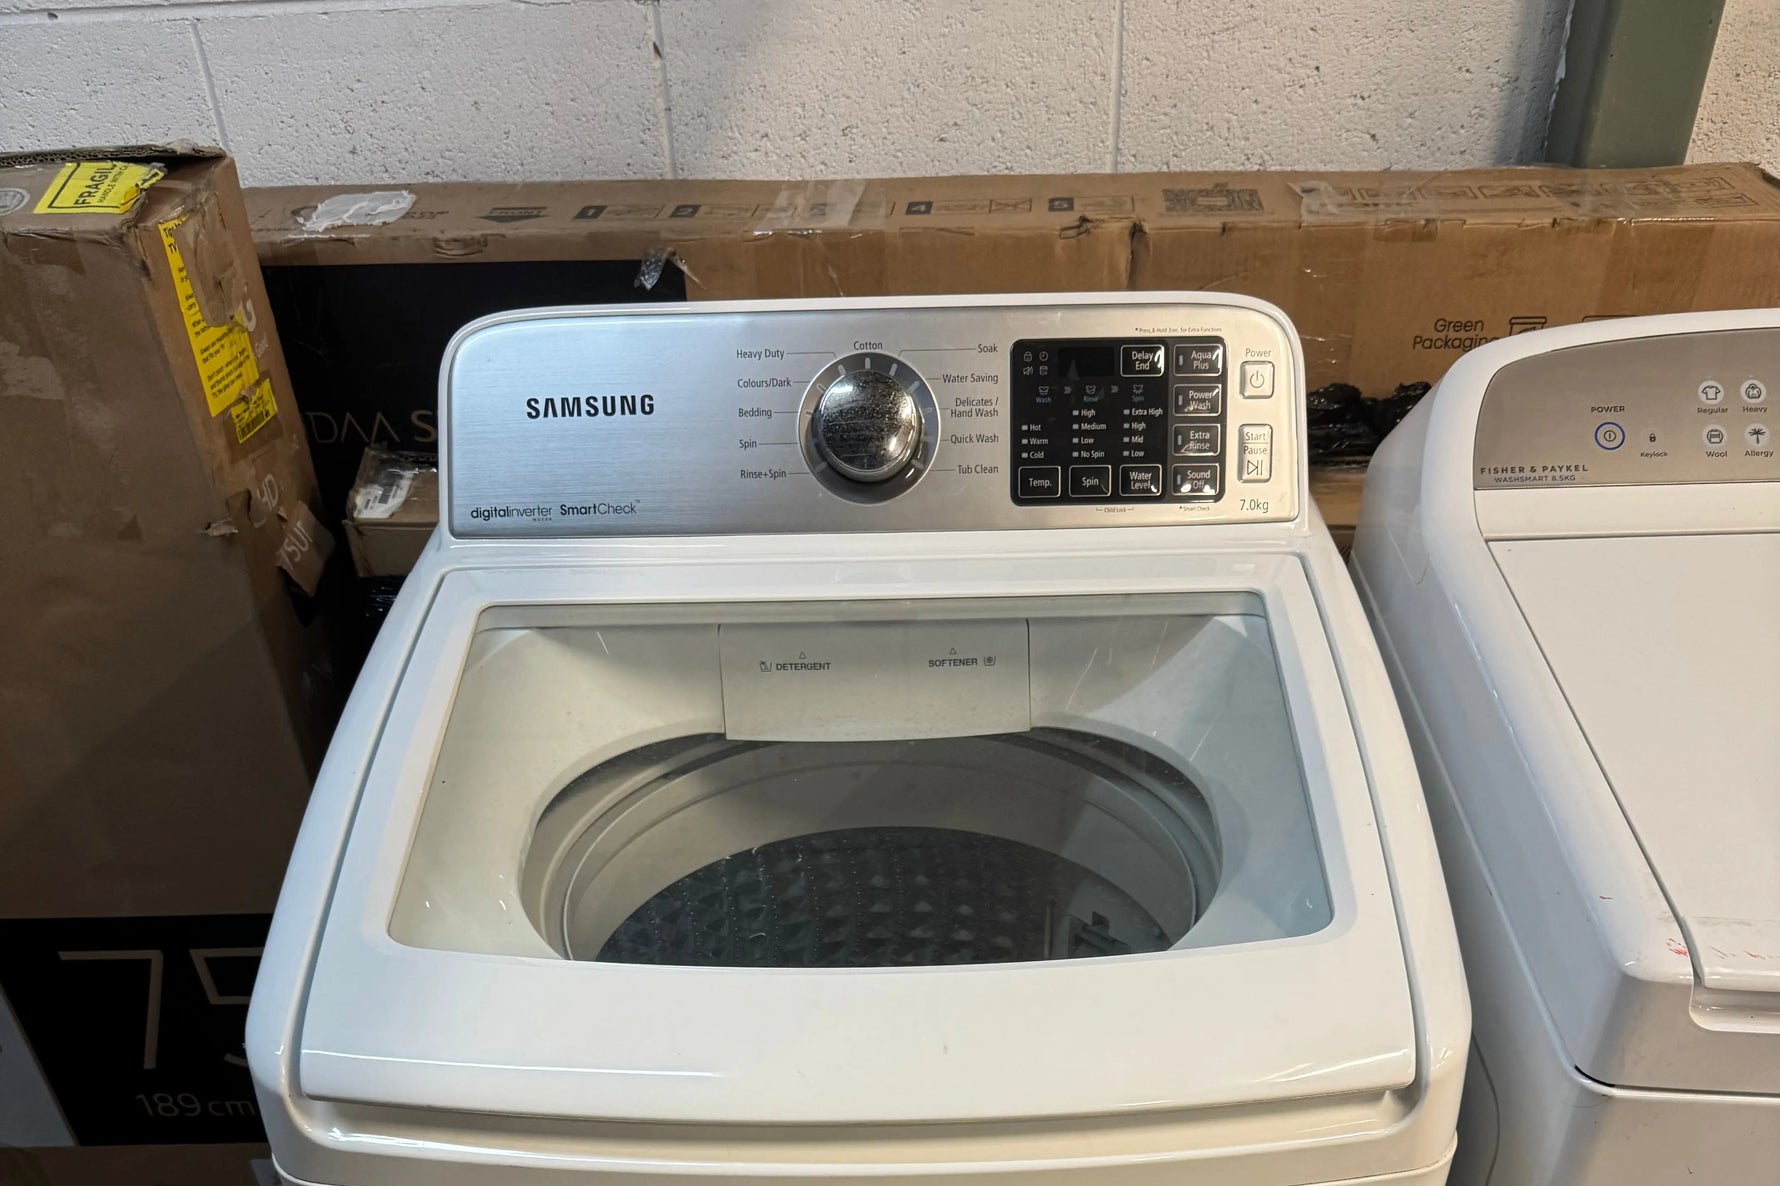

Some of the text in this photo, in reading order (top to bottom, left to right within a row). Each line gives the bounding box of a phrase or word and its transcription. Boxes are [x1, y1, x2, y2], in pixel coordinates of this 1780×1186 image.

[1433, 317, 1485, 333] Green
[853, 340, 883, 351] Cotton
[977, 343, 999, 354] Soak
[1412, 334, 1500, 353] Packagin
[736, 348, 784, 360] Heavy Duty
[1131, 350, 1154, 362] Delay
[1191, 350, 1212, 362] Aqua
[1245, 348, 1272, 359] Power
[1135, 360, 1150, 370] End
[1193, 360, 1210, 370] Plus
[737, 377, 791, 388] Colours/Dark
[942, 373, 999, 385] Water Saving
[1188, 390, 1212, 400] Power
[526, 394, 655, 420] SAMSUNG
[955, 396, 993, 407] Delicates
[1190, 400, 1211, 410] Wash
[738, 407, 772, 419] Bedding
[950, 408, 999, 418] Hand Wash
[1081, 409, 1096, 418] High
[1131, 407, 1163, 417] Extra High
[1590, 405, 1626, 414] POWER
[1697, 405, 1729, 416] Regular
[1742, 405, 1768, 415] Heavy
[1080, 423, 1107, 431] Medium
[1131, 421, 1146, 431] High
[950, 433, 999, 445] Quick Wash
[1189, 431, 1210, 440] Extra
[1245, 431, 1266, 442] Start
[739, 438, 758, 450] Spin
[1189, 440, 1210, 451] Rinse
[1029, 451, 1044, 459] Cold
[1080, 450, 1105, 459] No Spin
[1131, 450, 1145, 458] Low
[1243, 445, 1268, 455] Pause
[1640, 450, 1669, 459] Keylock
[1705, 450, 1728, 459] Wool
[1744, 448, 1774, 459] Allergy
[740, 468, 787, 480] Rinse+Spin
[957, 464, 999, 474] Tub Clean
[1480, 464, 1589, 476] FISHER & PAYKEL
[1129, 471, 1152, 481] Water
[1187, 470, 1211, 480] Sound
[1493, 474, 1576, 484] WASHSMART 8.5KG
[1028, 478, 1052, 489] Temp.
[1081, 476, 1099, 489] Spin
[1130, 480, 1151, 490] Level
[1192, 479, 1206, 490] Off
[1239, 498, 1269, 513] 7.0kg
[470, 505, 552, 521] digitalinverter
[775, 662, 831, 672] DETERGENT
[928, 658, 978, 668] SOFTENER
[135, 1091, 256, 1118] 189 cm
